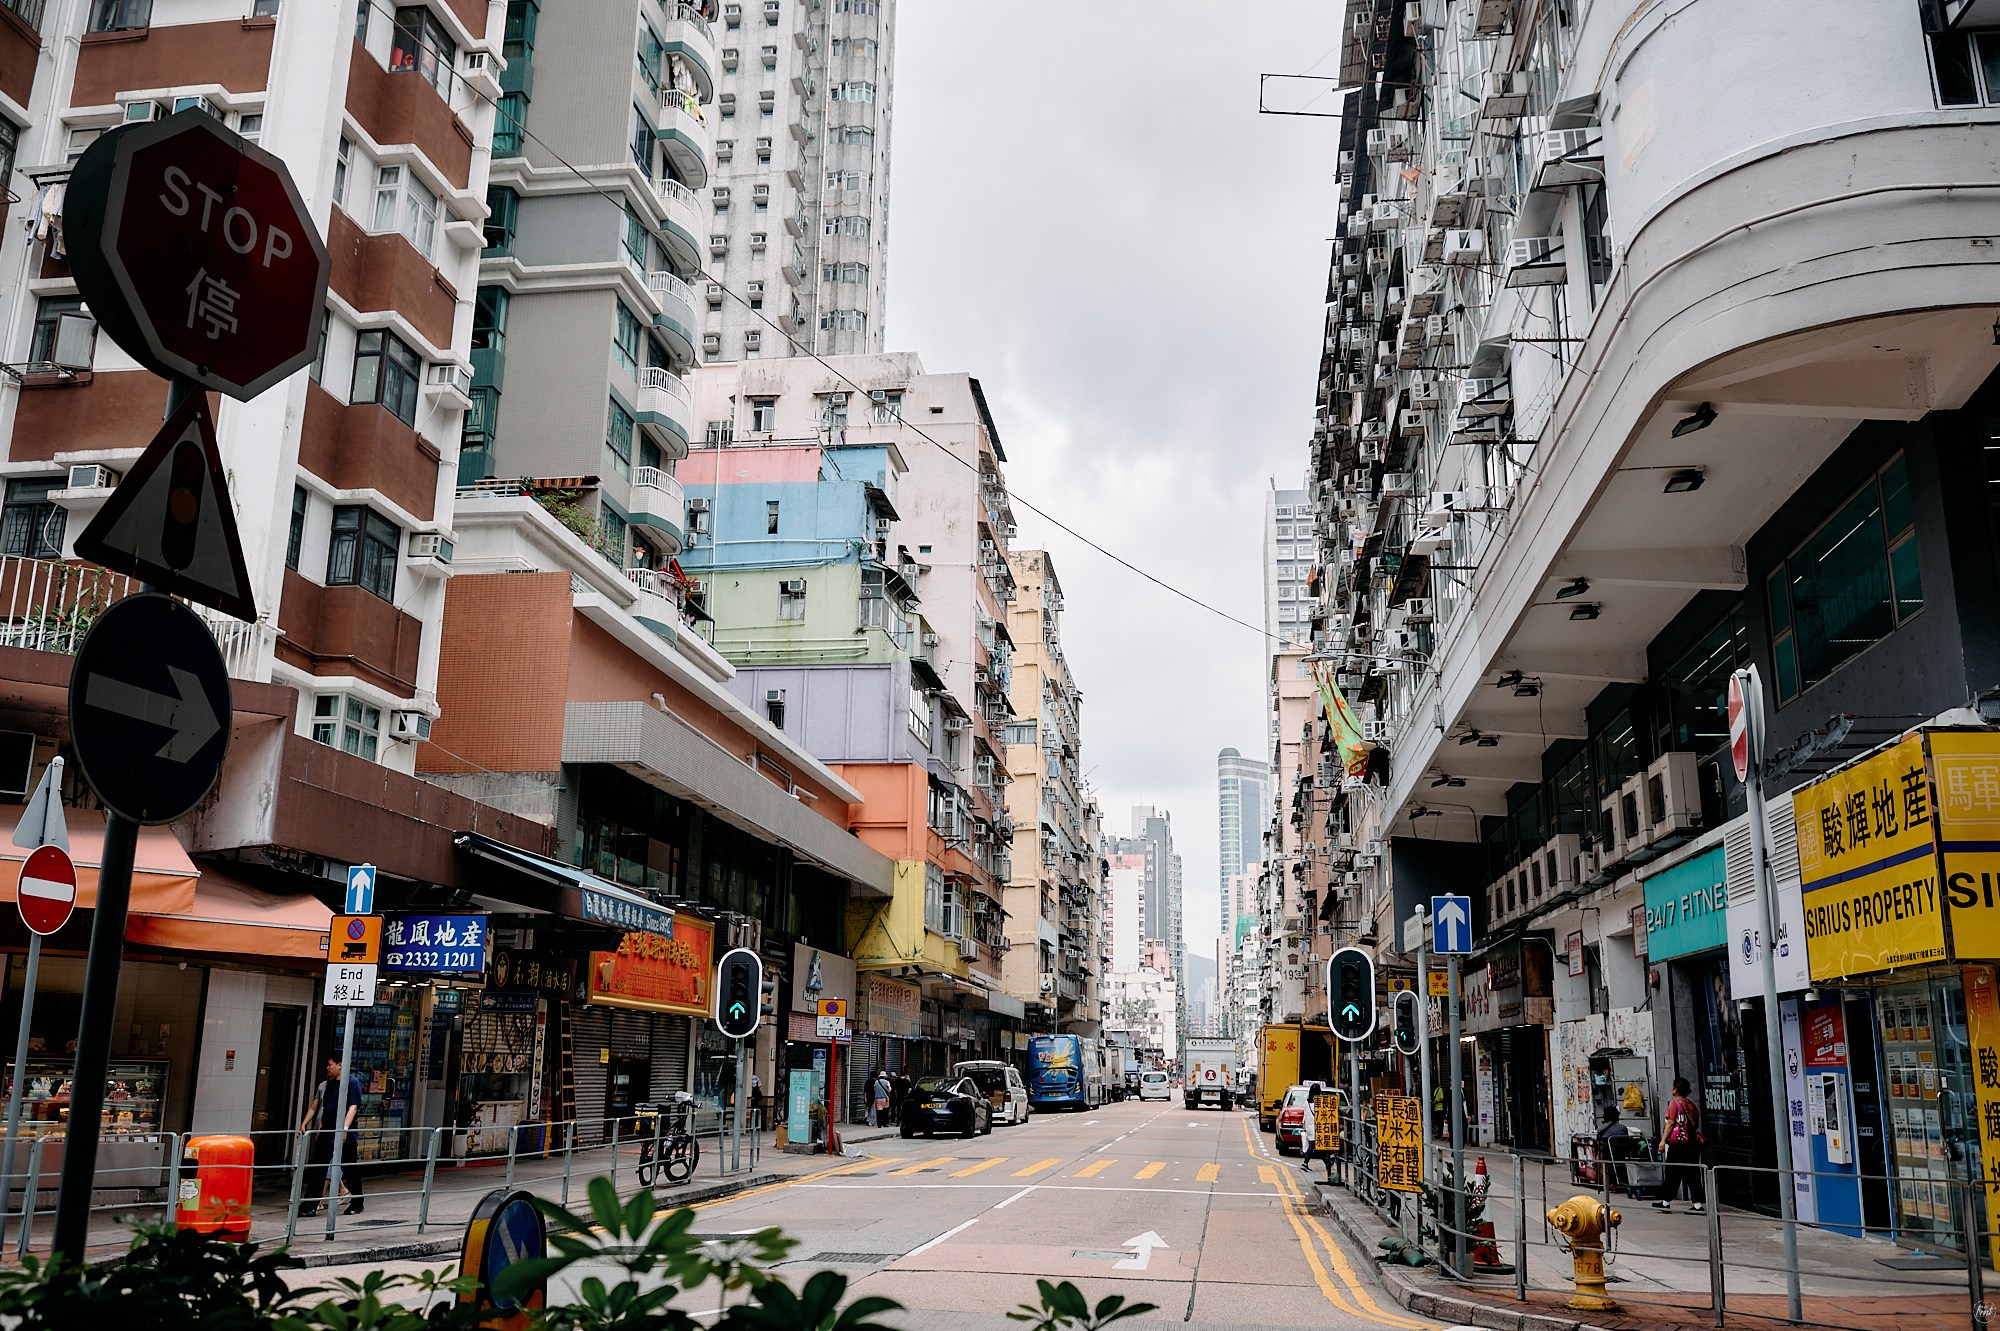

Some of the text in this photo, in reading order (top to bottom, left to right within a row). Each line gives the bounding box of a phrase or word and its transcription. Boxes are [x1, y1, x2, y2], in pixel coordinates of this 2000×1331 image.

[159, 166, 293, 268] STOP
[186, 266, 241, 340] 停
[1948, 872, 2000, 909] SI
[646, 913, 660, 931] Since
[659, 916, 672, 934] 1992
[1646, 900, 1676, 933] 24/7
[1806, 901, 1851, 939] SIRIUS
[1854, 876, 1935, 931] PROPERTY
[340, 967, 363, 980] End
[404, 952, 475, 967] 2332 1201
[333, 984, 365, 1001] 終止
